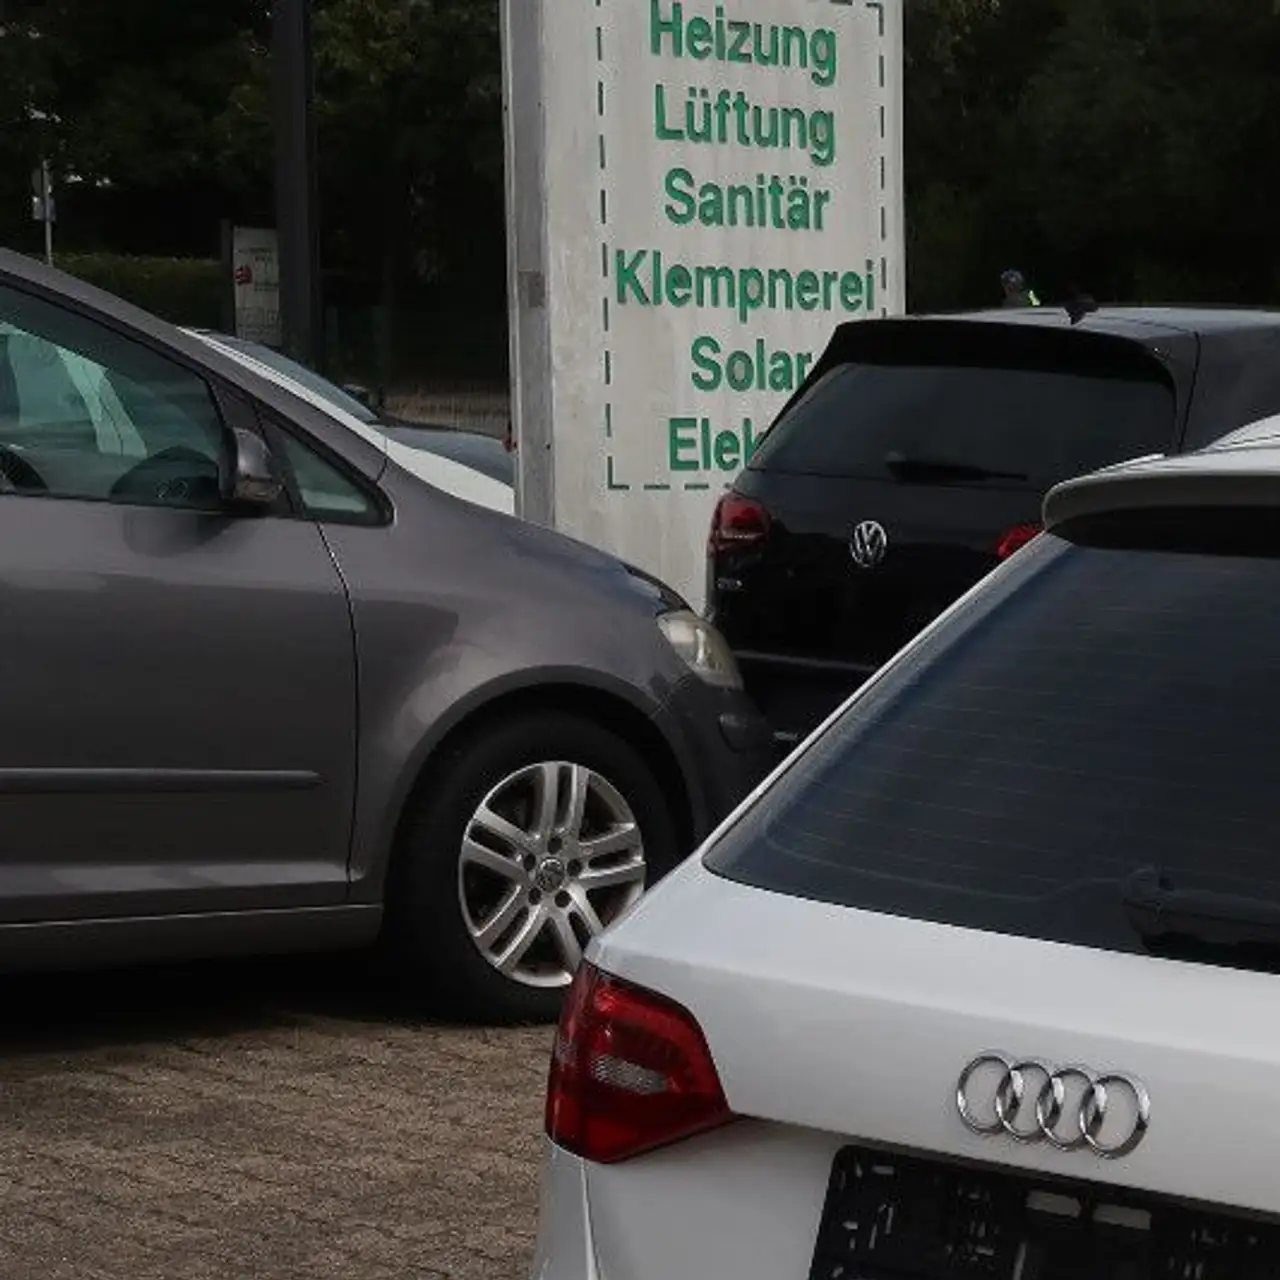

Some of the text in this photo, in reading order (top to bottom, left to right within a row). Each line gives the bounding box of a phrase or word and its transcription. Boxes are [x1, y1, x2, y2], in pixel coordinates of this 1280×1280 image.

[649, 0, 837, 86] Heizung
[654, 84, 836, 167] Lüftung
[664, 167, 830, 231] Sanitär
[614, 249, 876, 323] Klempnerei
[690, 336, 813, 393] Solar
